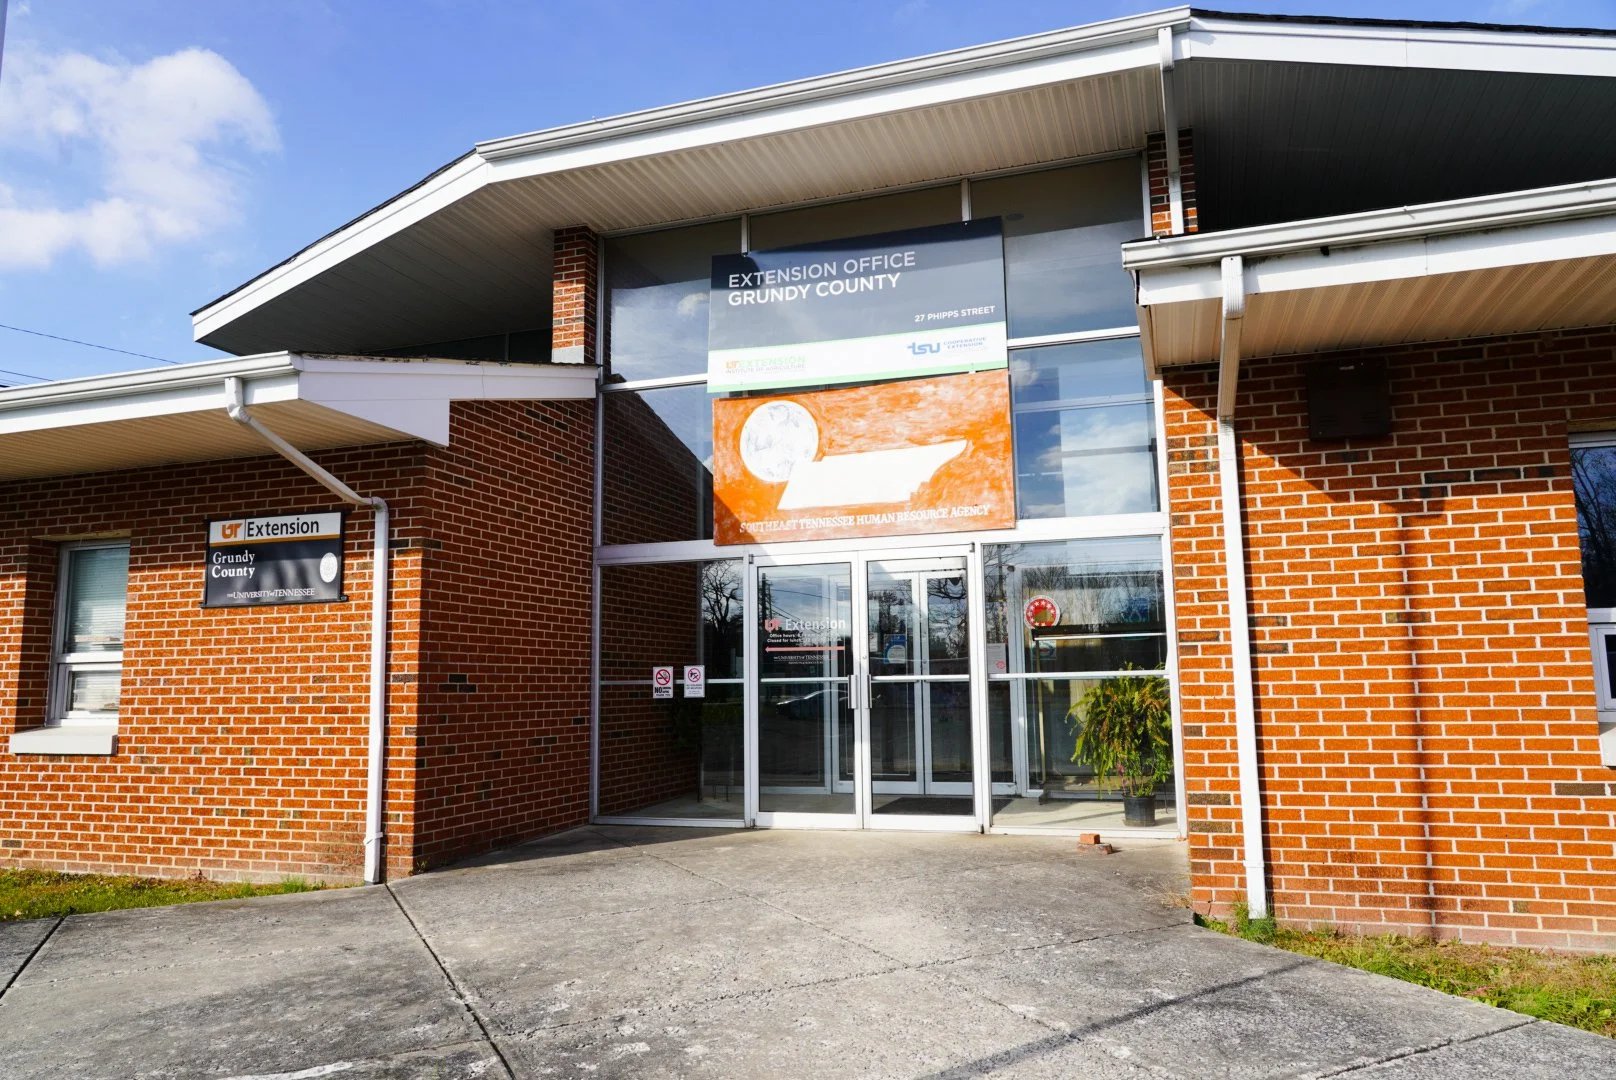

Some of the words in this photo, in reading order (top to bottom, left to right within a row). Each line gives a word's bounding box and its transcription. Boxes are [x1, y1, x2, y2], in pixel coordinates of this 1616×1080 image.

[729, 261, 837, 288] EXTENSION
[843, 251, 916, 274] OFFICE
[728, 284, 811, 306] GRUNDY
[816, 272, 901, 297] COUNTY
[914, 313, 926, 323] 27
[927, 309, 959, 321] PHIPPS
[960, 305, 996, 317] STREET
[739, 520, 799, 533] SOUTHEAST
[799, 515, 855, 530] TENNESSEE
[856, 513, 895, 526] HUMAN
[897, 508, 948, 522] RESOURCE
[950, 504, 991, 518] AGENCY
[221, 523, 243, 540] UT
[247, 517, 320, 537] Extension
[213, 550, 256, 565] Grundy
[212, 565, 256, 579] County
[233, 590, 271, 599] UNIVERSITY
[274, 588, 316, 597] TENNESSEE
[785, 617, 846, 631] Extension
